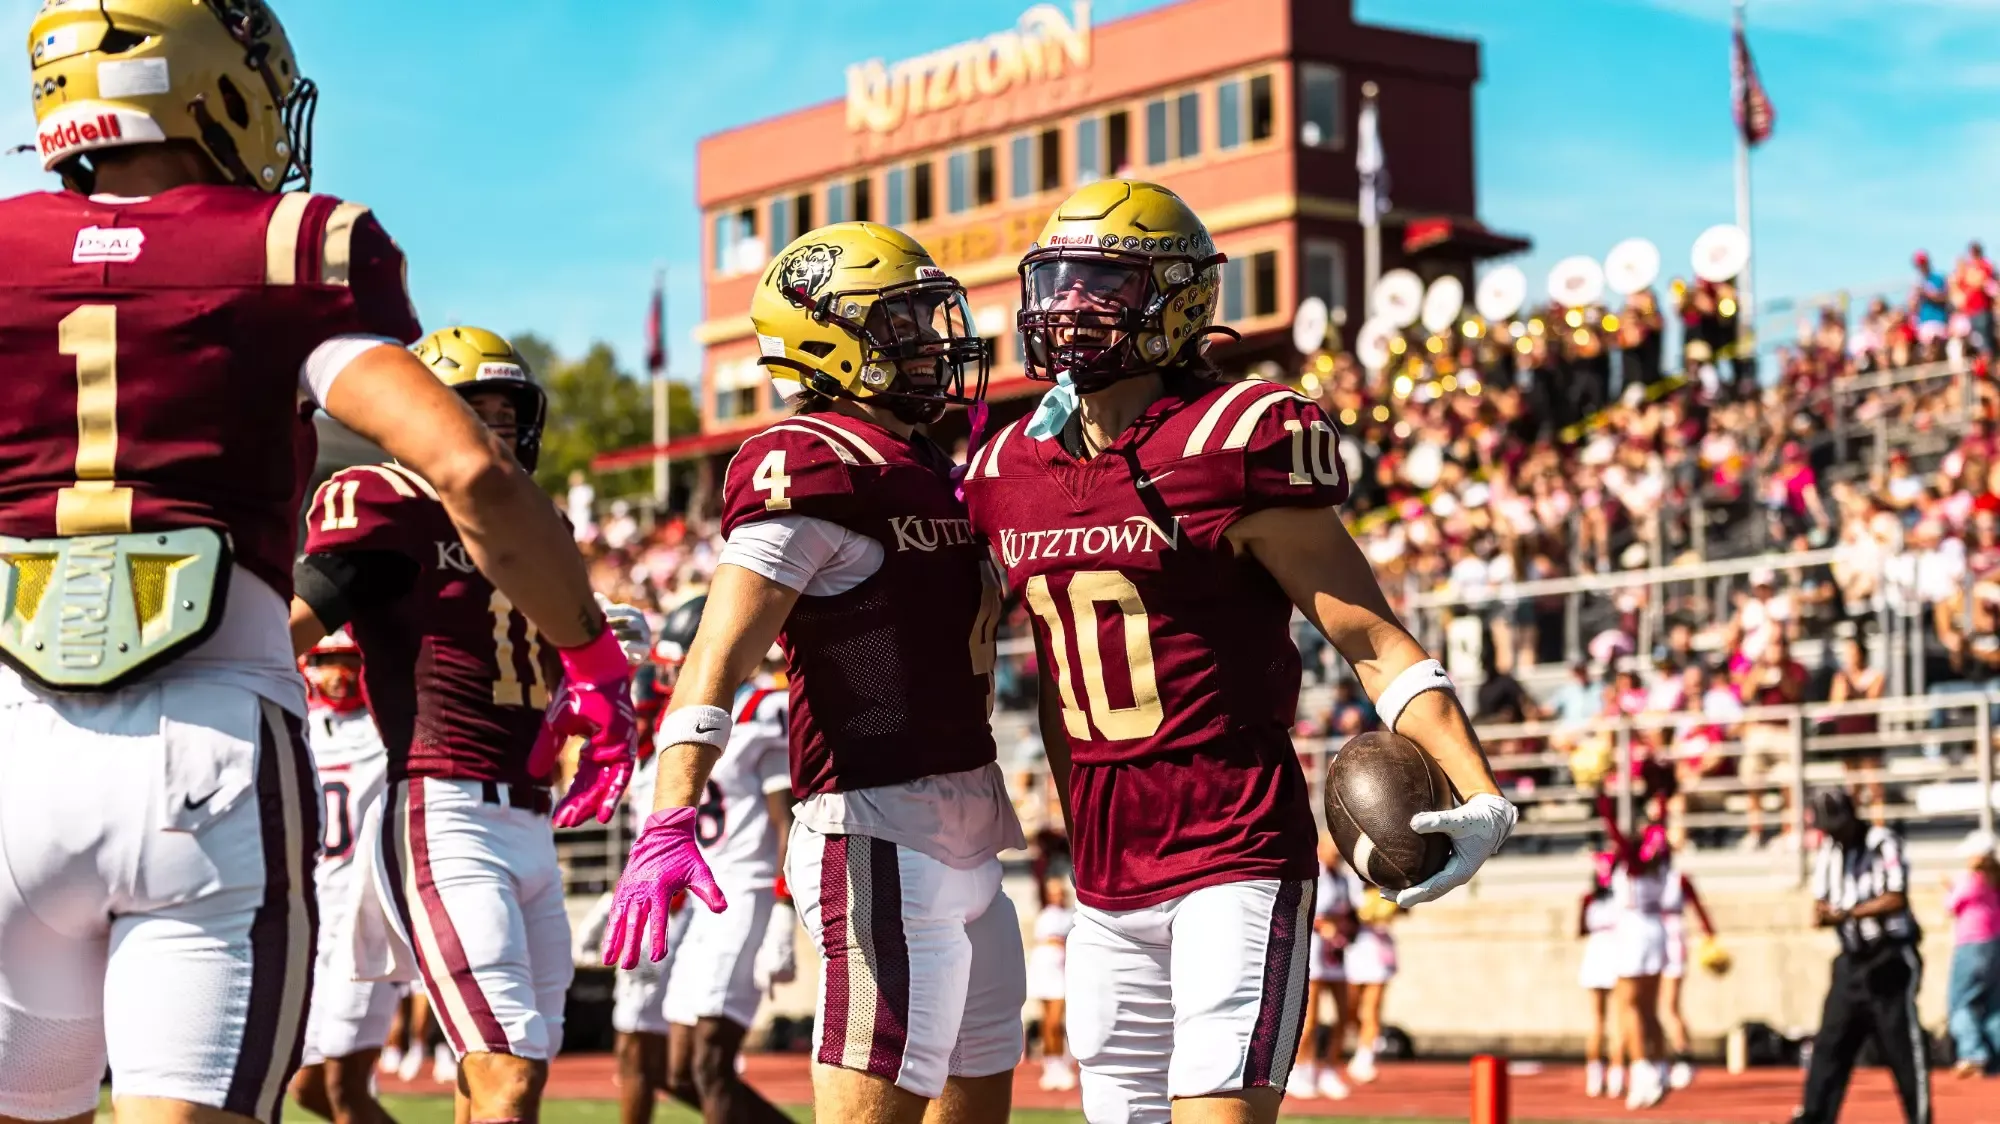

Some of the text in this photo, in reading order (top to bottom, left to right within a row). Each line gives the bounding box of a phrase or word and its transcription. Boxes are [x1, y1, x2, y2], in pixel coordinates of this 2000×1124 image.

[846, 0, 1092, 134] KUTZTOWN
[1050, 234, 1094, 245] Riddell
[56, 304, 133, 537] 1
[1283, 420, 1340, 487] 10
[320, 480, 361, 531] 11
[752, 450, 791, 511] 4
[887, 515, 977, 552] KUTZT
[999, 515, 1182, 568] KUTZTOWN
[57, 536, 118, 671] NXTRND
[488, 588, 549, 711] 11
[1025, 570, 1165, 742] 10
